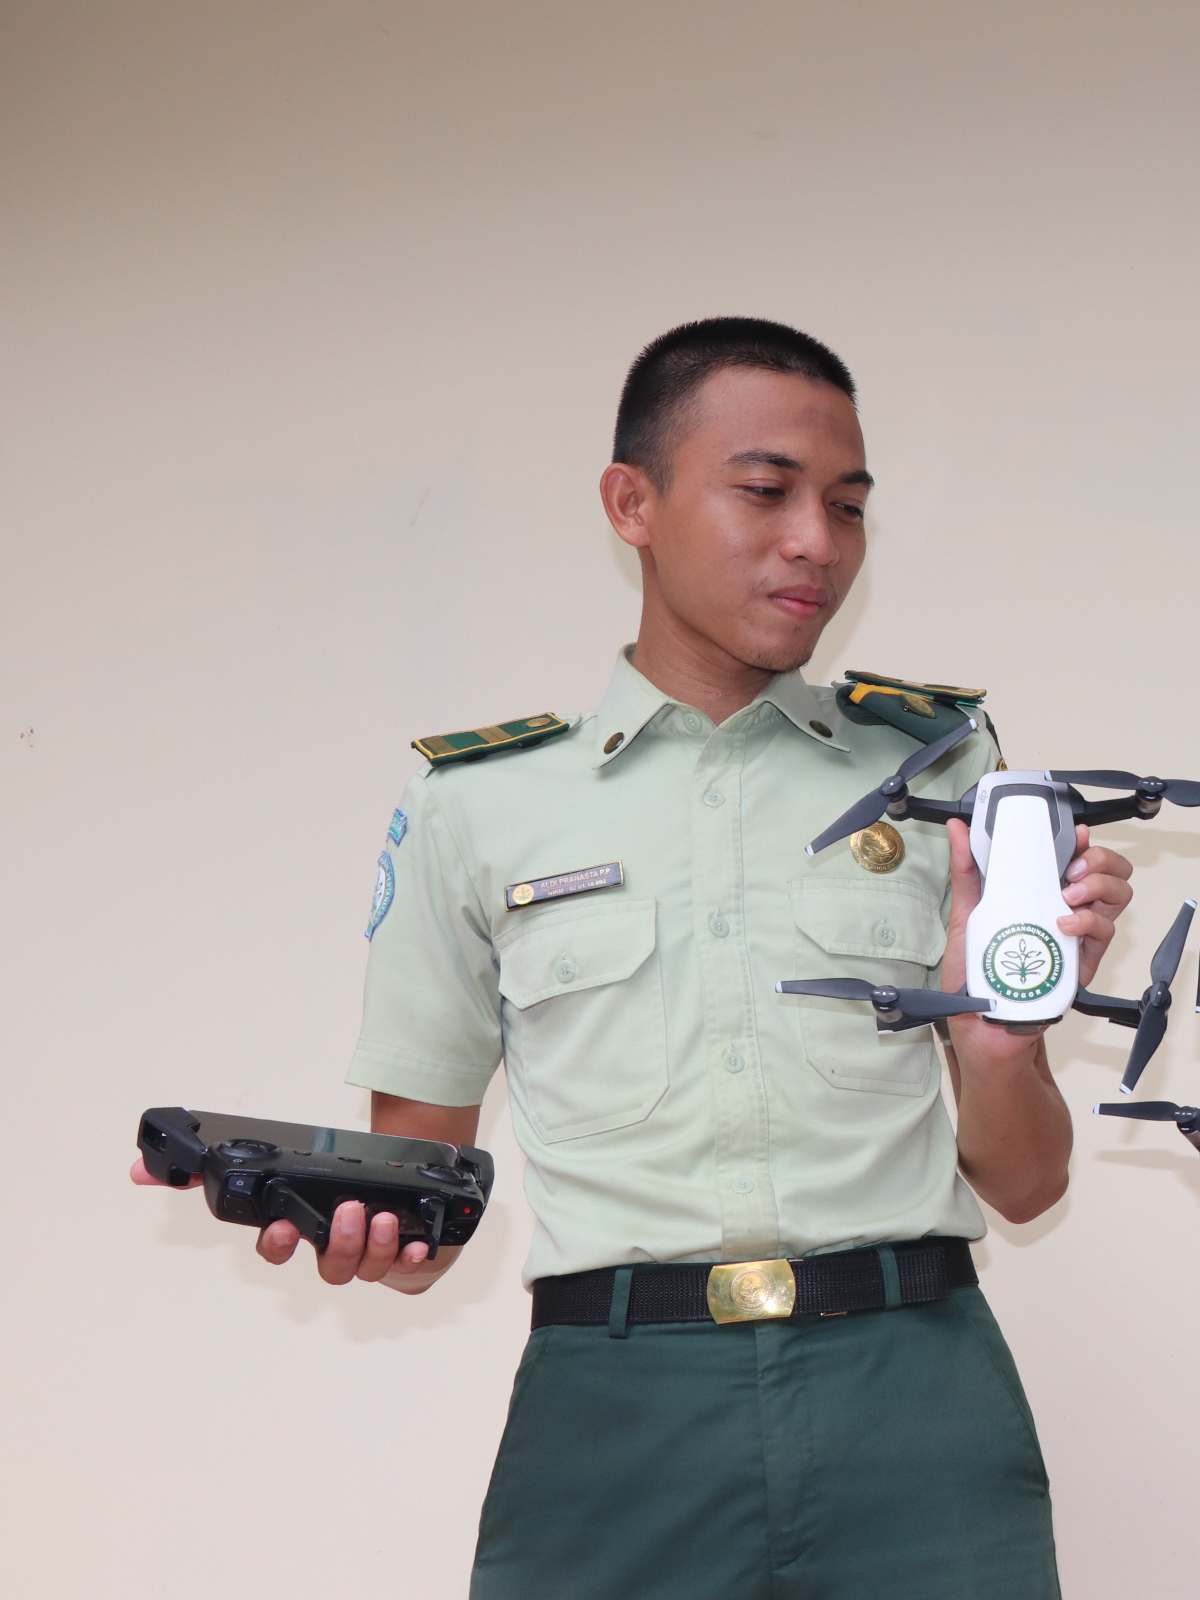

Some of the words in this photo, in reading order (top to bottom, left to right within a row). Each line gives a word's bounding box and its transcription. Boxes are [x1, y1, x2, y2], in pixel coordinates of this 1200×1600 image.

[541, 881, 557, 889] ALDI
[559, 871, 598, 884] PRAHASTA
[985, 942, 998, 983] POLITEKNIK
[997, 926, 1050, 941] PEMBANGUNAN
[1048, 942, 1061, 982] PERTANIAN
[1005, 989, 1042, 998] BOGOR
